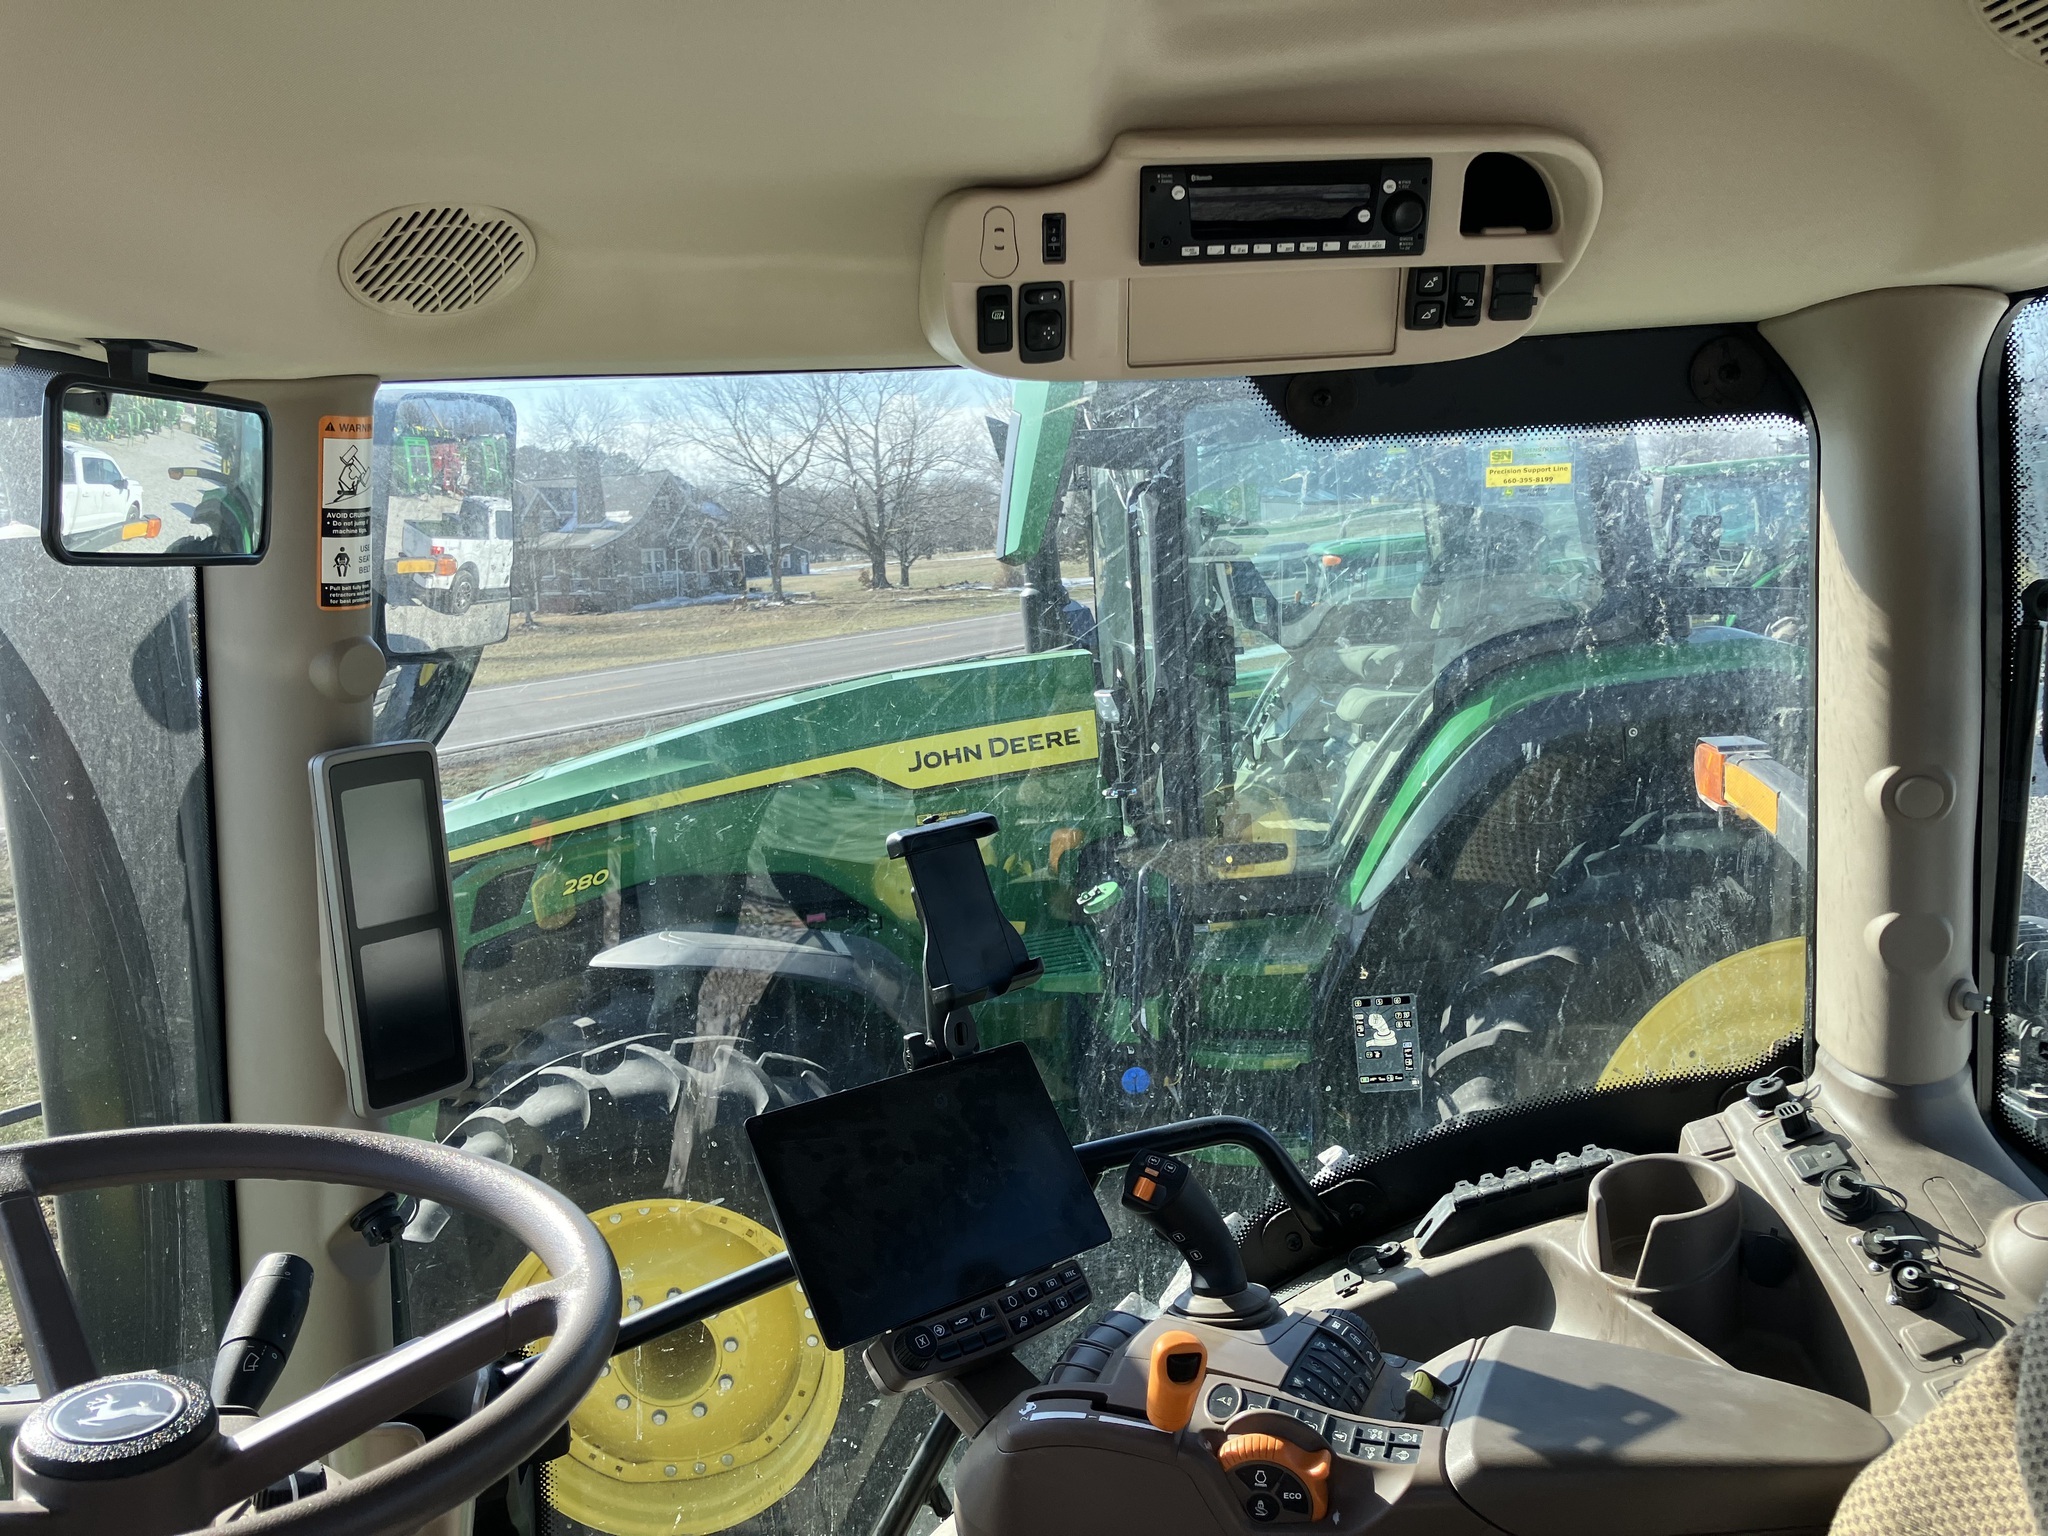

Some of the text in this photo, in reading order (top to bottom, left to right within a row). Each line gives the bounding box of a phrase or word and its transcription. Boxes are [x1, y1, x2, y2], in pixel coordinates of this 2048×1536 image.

[1491, 450, 1512, 460] SN
[1489, 467, 1521, 475] Precision
[1523, 466, 1551, 474] Support
[1503, 476, 1554, 484] 660-395-8199
[908, 728, 1081, 773] JOHN DEERE
[562, 869, 610, 896] 280
[1283, 1492, 1302, 1500] ECO
